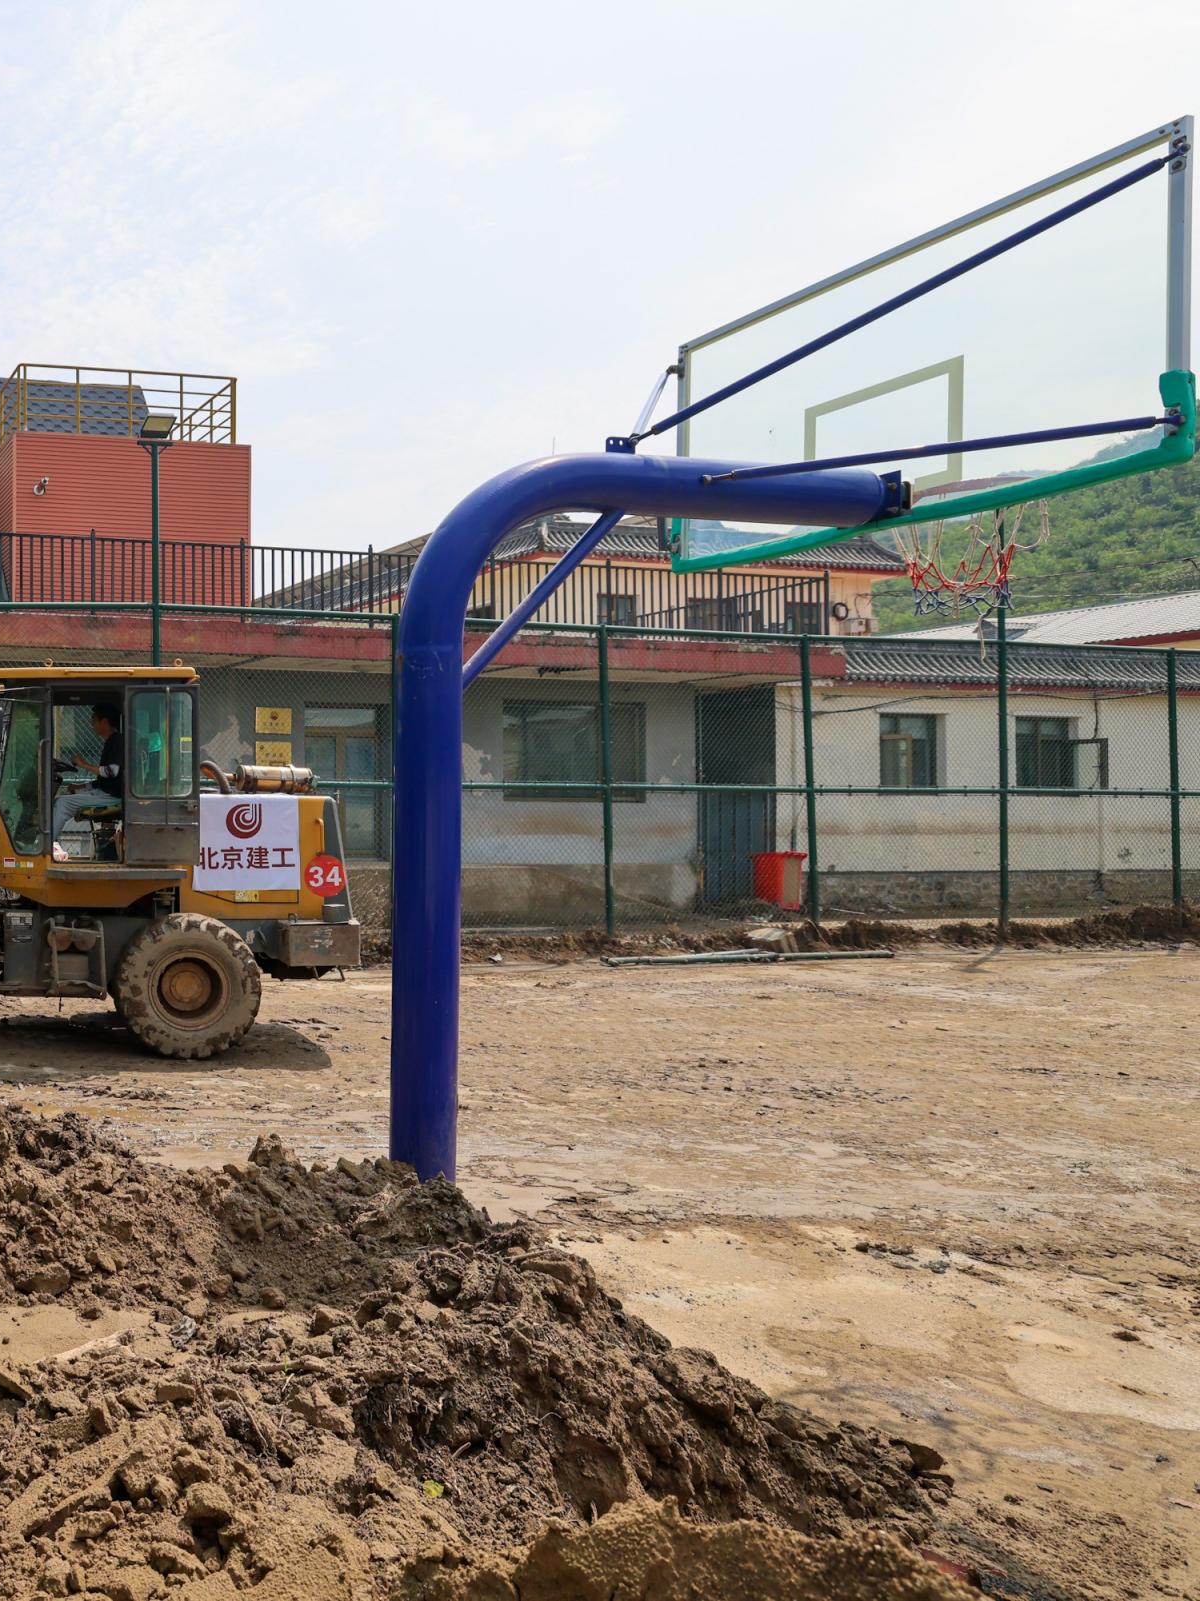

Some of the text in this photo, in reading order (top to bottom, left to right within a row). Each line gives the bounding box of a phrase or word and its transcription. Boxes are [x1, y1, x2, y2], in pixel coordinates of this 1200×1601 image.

[199, 847, 295, 870] 北京建工
[308, 866, 342, 887] 34
